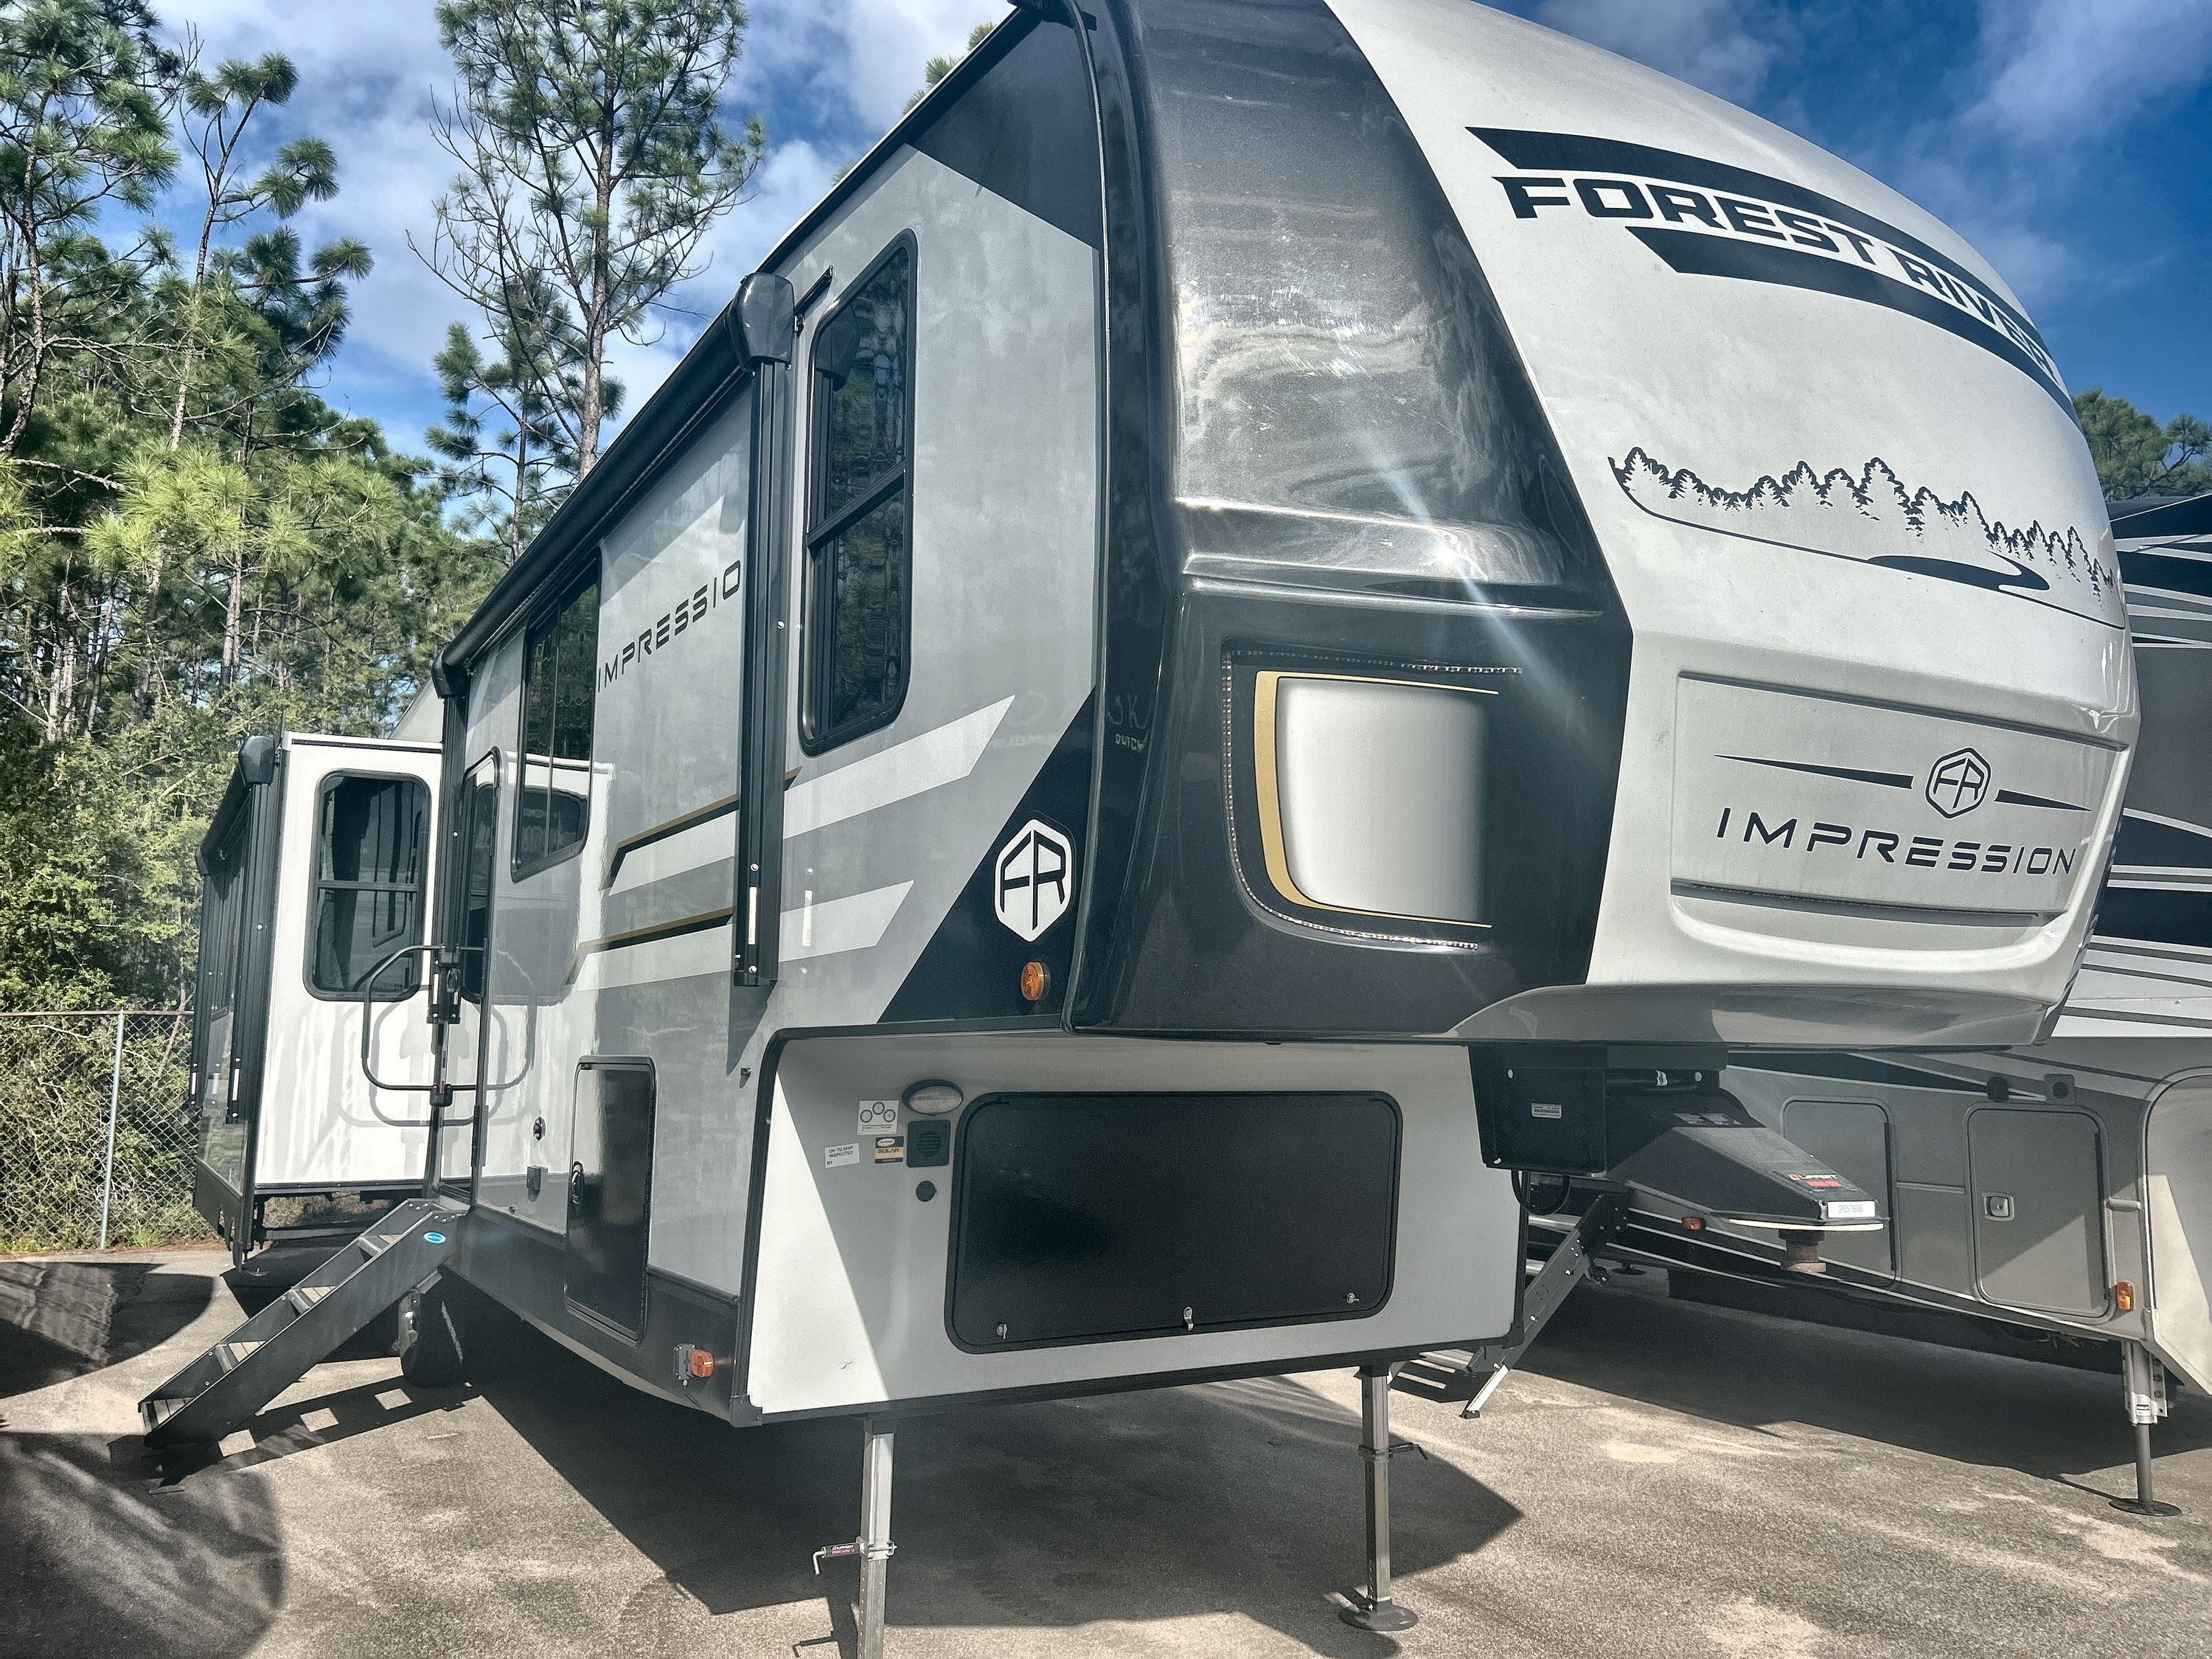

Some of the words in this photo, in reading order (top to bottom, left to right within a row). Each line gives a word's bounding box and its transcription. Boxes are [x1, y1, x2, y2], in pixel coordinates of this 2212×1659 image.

[1492, 176, 1876, 265] FOREST
[1885, 246, 2060, 386] RIVER
[597, 560, 741, 693] IMPRESSIO
[1716, 807, 2077, 876] IMPRESSION
